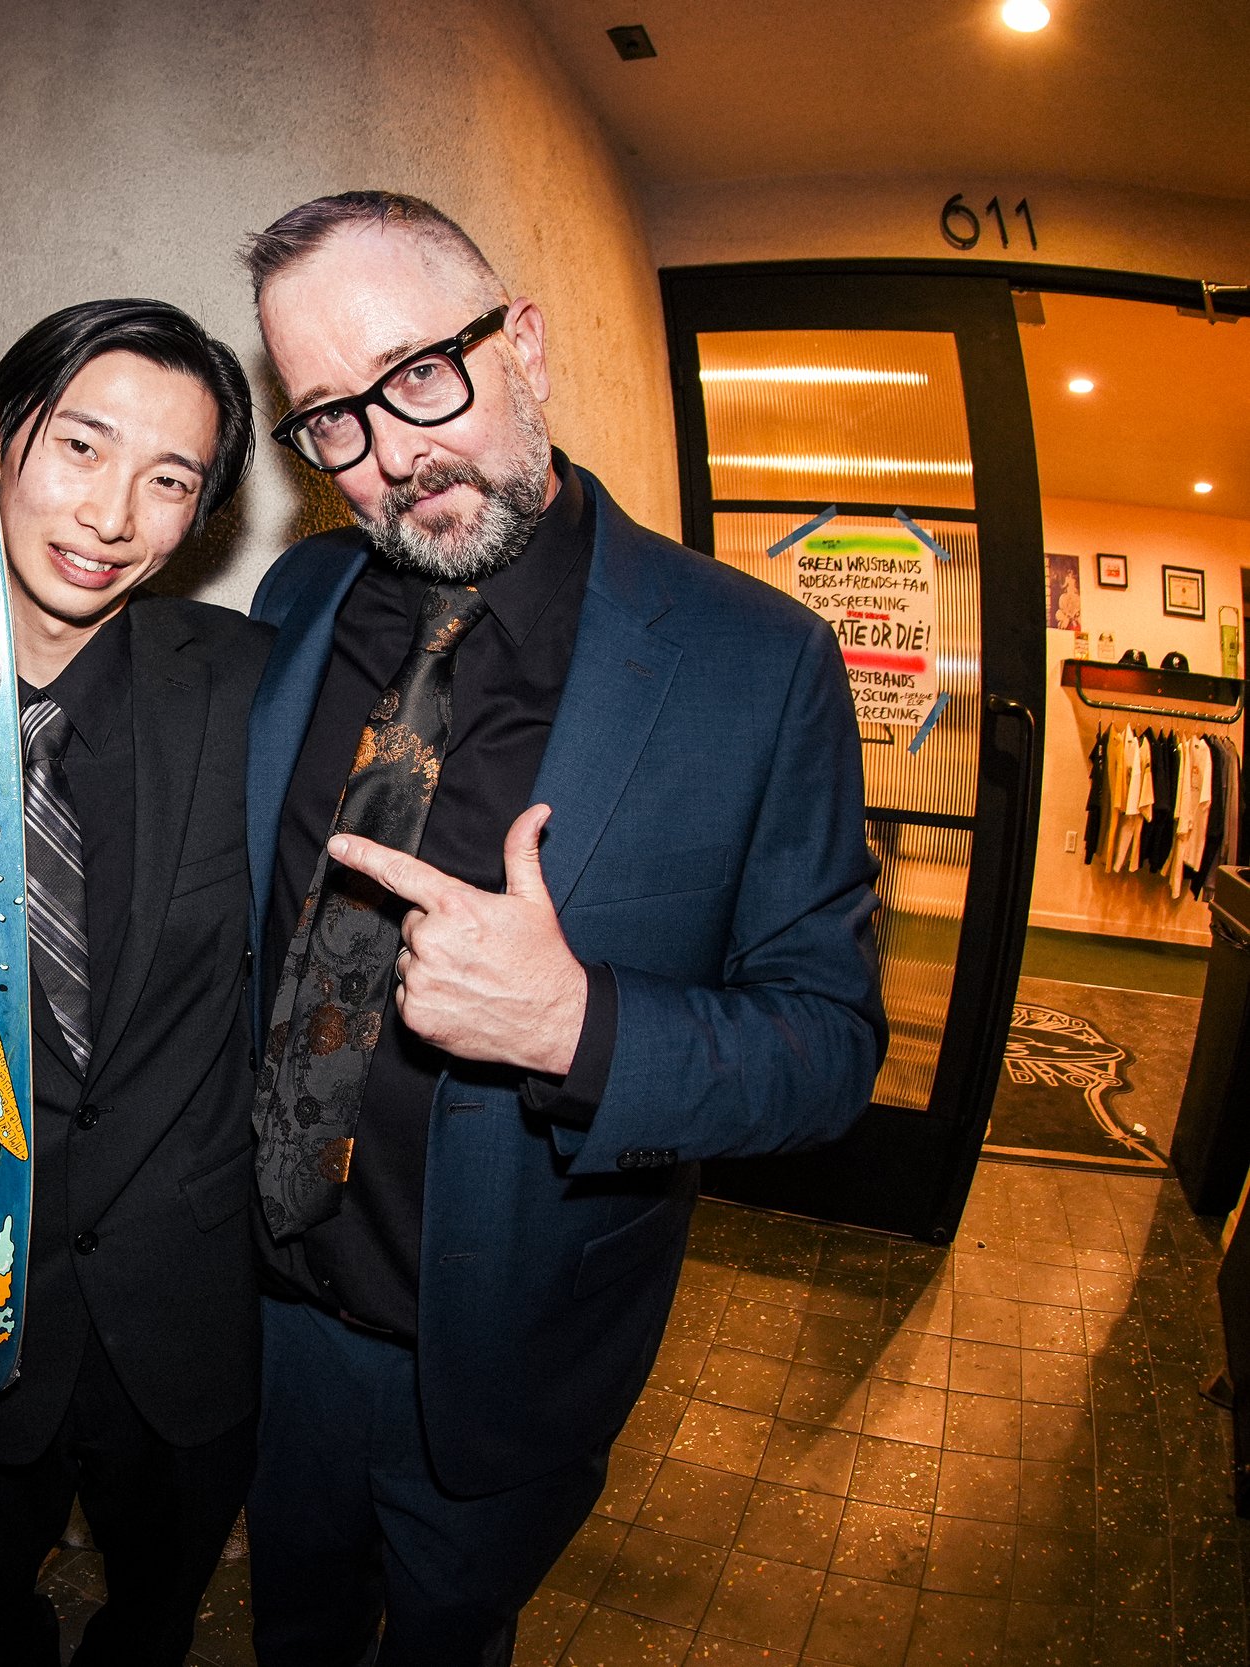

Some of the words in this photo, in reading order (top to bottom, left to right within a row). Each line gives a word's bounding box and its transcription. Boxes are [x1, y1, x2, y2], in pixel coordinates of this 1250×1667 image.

[940, 193, 1037, 250] 611
[798, 556, 842, 571] GREEN
[847, 556, 922, 574] WRISTBANDS
[831, 594, 910, 612] SCREENING
[871, 622, 892, 649] OR
[896, 620, 932, 651] DIE!
[848, 668, 916, 689] RISTBANDS
[861, 688, 899, 704] SCUM
[856, 706, 923, 723] CREENING
